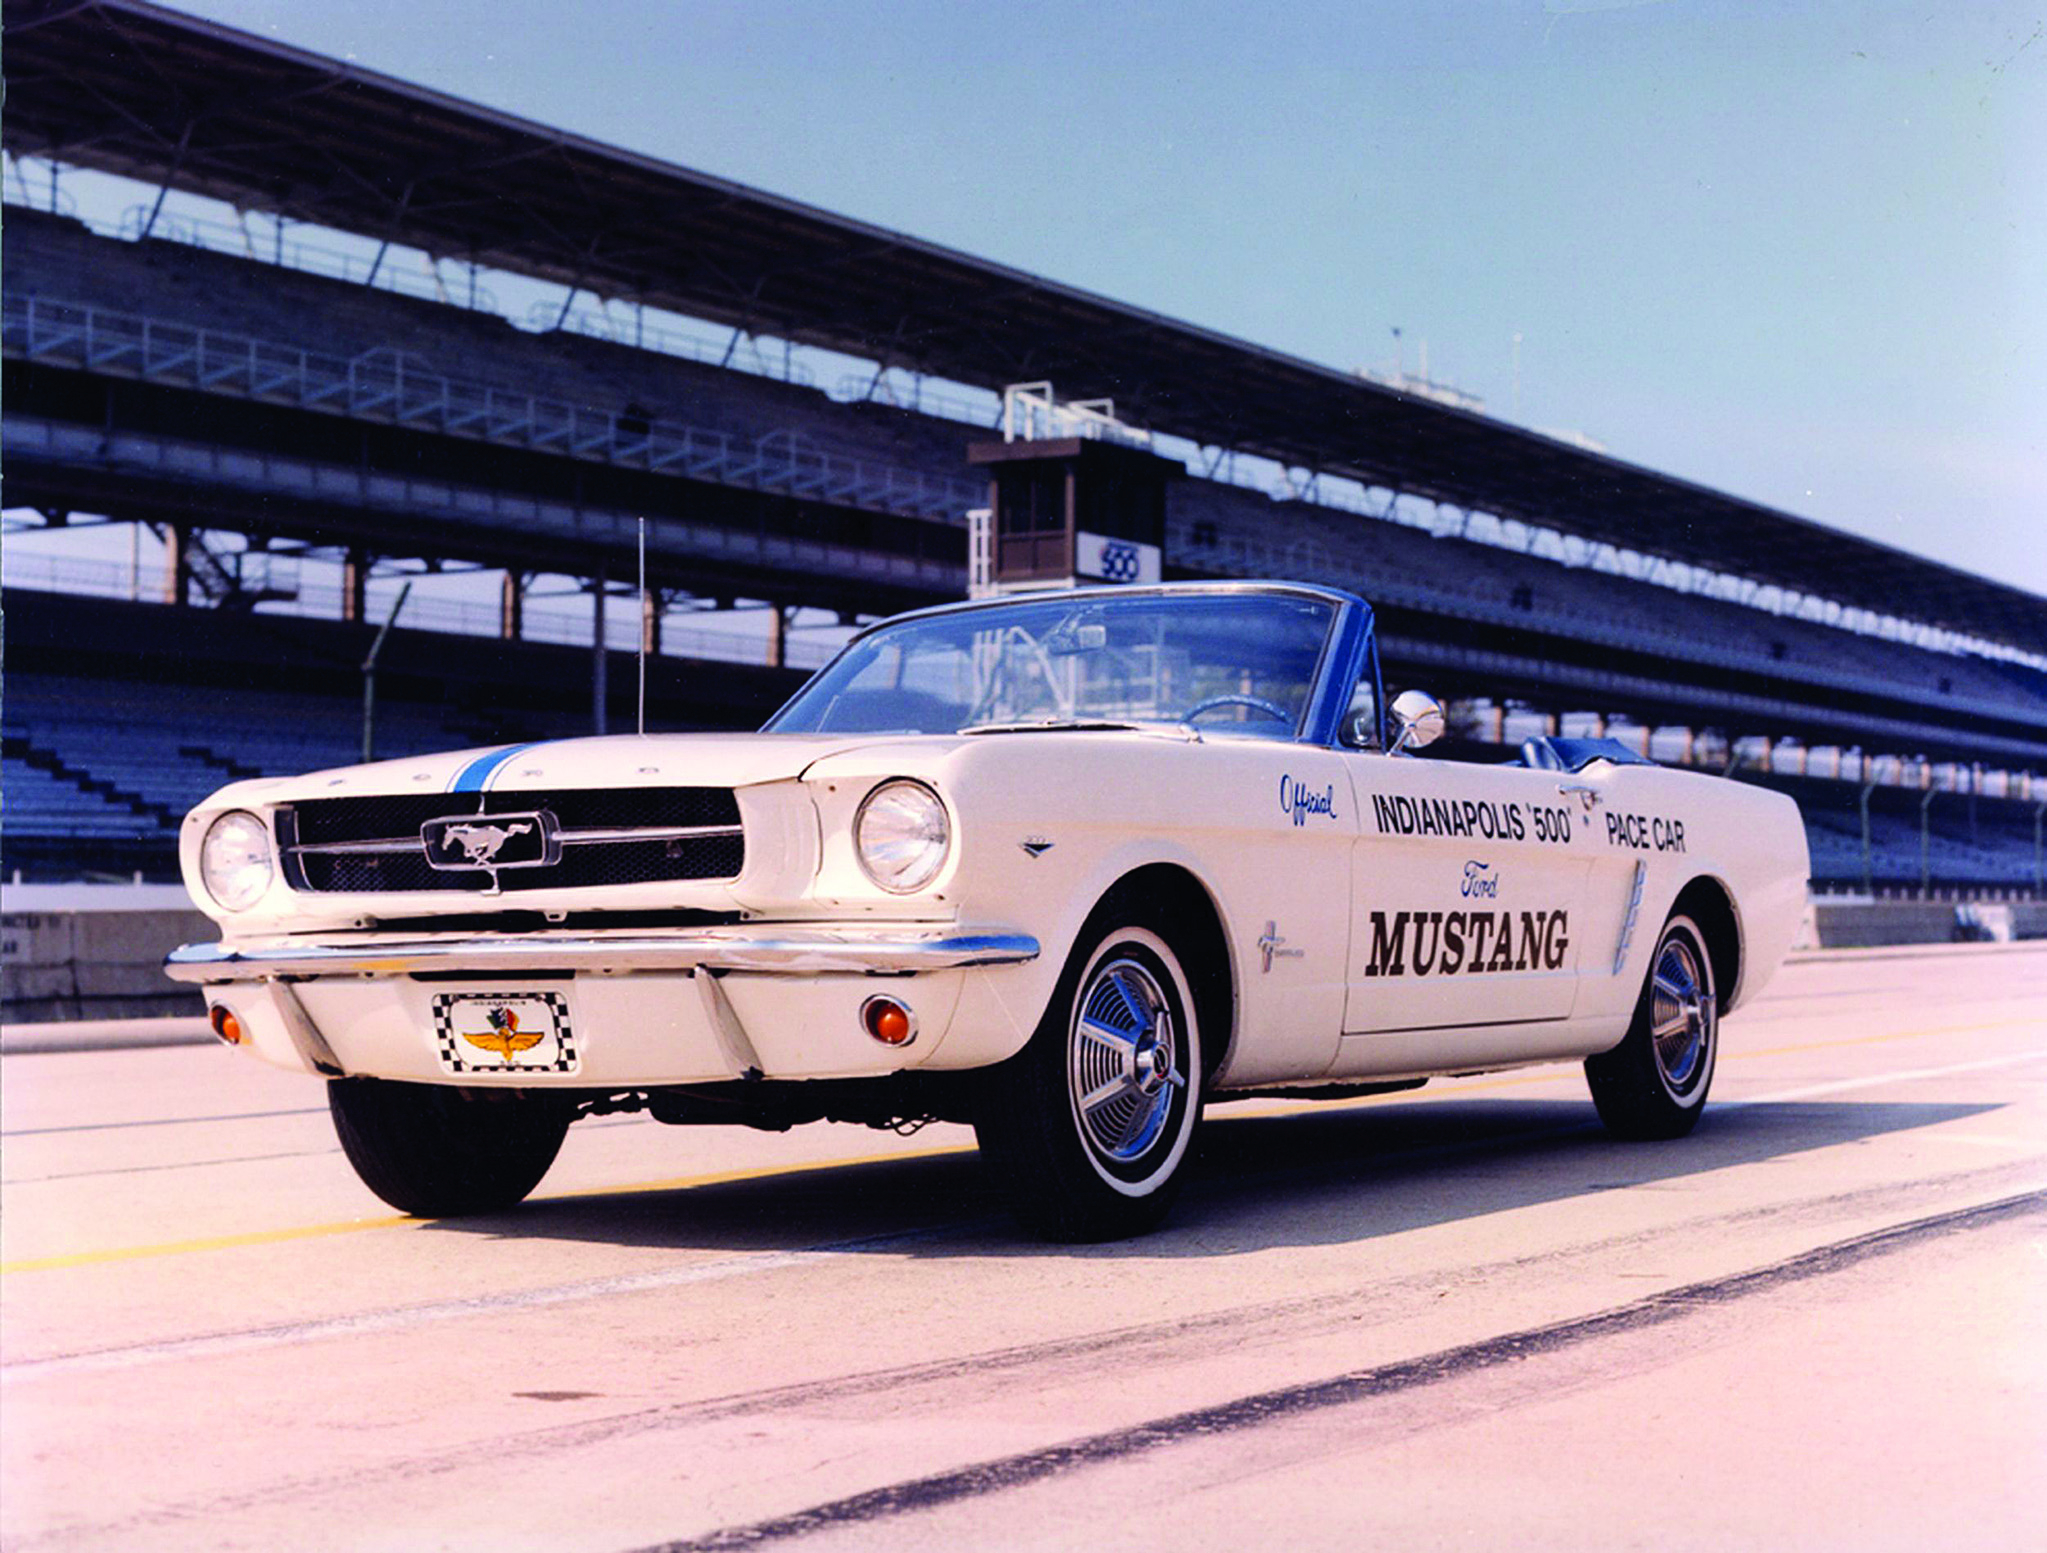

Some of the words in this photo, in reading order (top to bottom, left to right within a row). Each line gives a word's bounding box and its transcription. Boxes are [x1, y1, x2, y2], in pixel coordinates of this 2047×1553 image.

[1101, 542, 1140, 579] 500
[1280, 774, 1337, 827] Official
[1371, 794, 1526, 841] INDIANAPOLIS
[1605, 811, 1651, 849] PACE
[1652, 817, 1686, 853] CAR
[1461, 859, 1499, 899] Ford
[1364, 909, 1569, 976] MUSTANG
